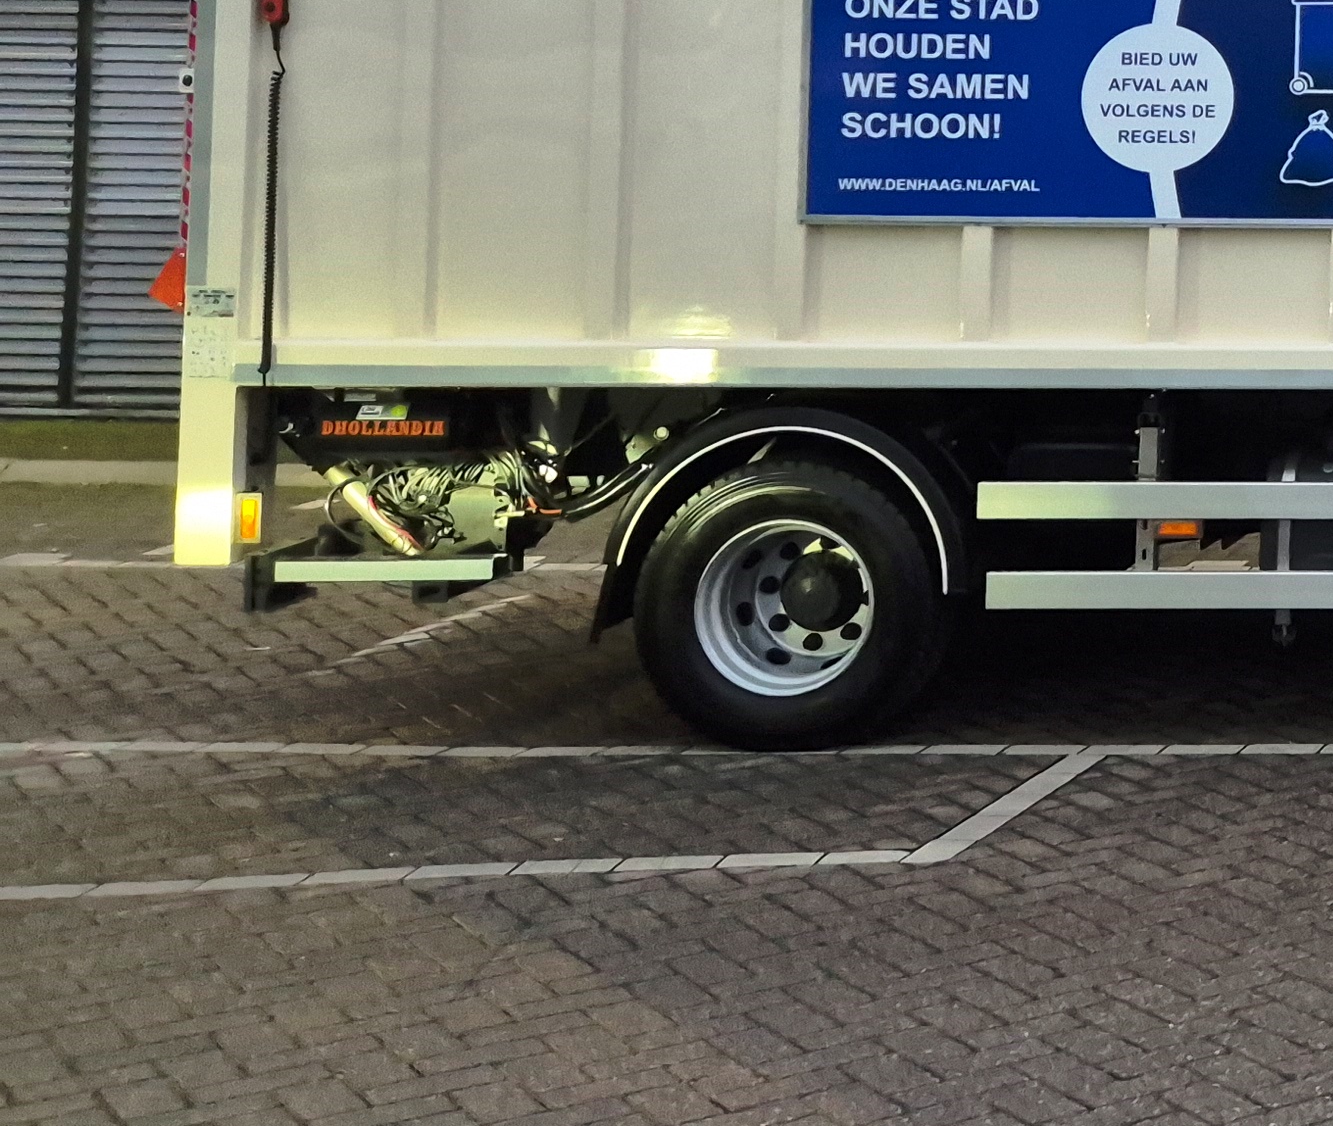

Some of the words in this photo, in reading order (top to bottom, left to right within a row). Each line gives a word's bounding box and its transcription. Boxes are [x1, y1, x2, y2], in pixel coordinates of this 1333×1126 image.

[844, 32, 991, 60] HOUDEN
[1121, 52, 1163, 66] BIED
[1169, 52, 1198, 67] UW
[841, 72, 897, 99] WE
[907, 73, 1030, 100] SAMEN
[1108, 78, 1166, 92] AFVAL
[1170, 78, 1208, 92] AAN
[1100, 103, 1186, 118] VOLGENS
[1192, 104, 1216, 118] DE
[840, 112, 1001, 139] SCHOON!
[1118, 129, 1196, 144] REGELS!
[838, 178, 1041, 192] WWW.DENHAAG.NL/AFVAL
[321, 420, 445, 436] DHOLLANDIA
